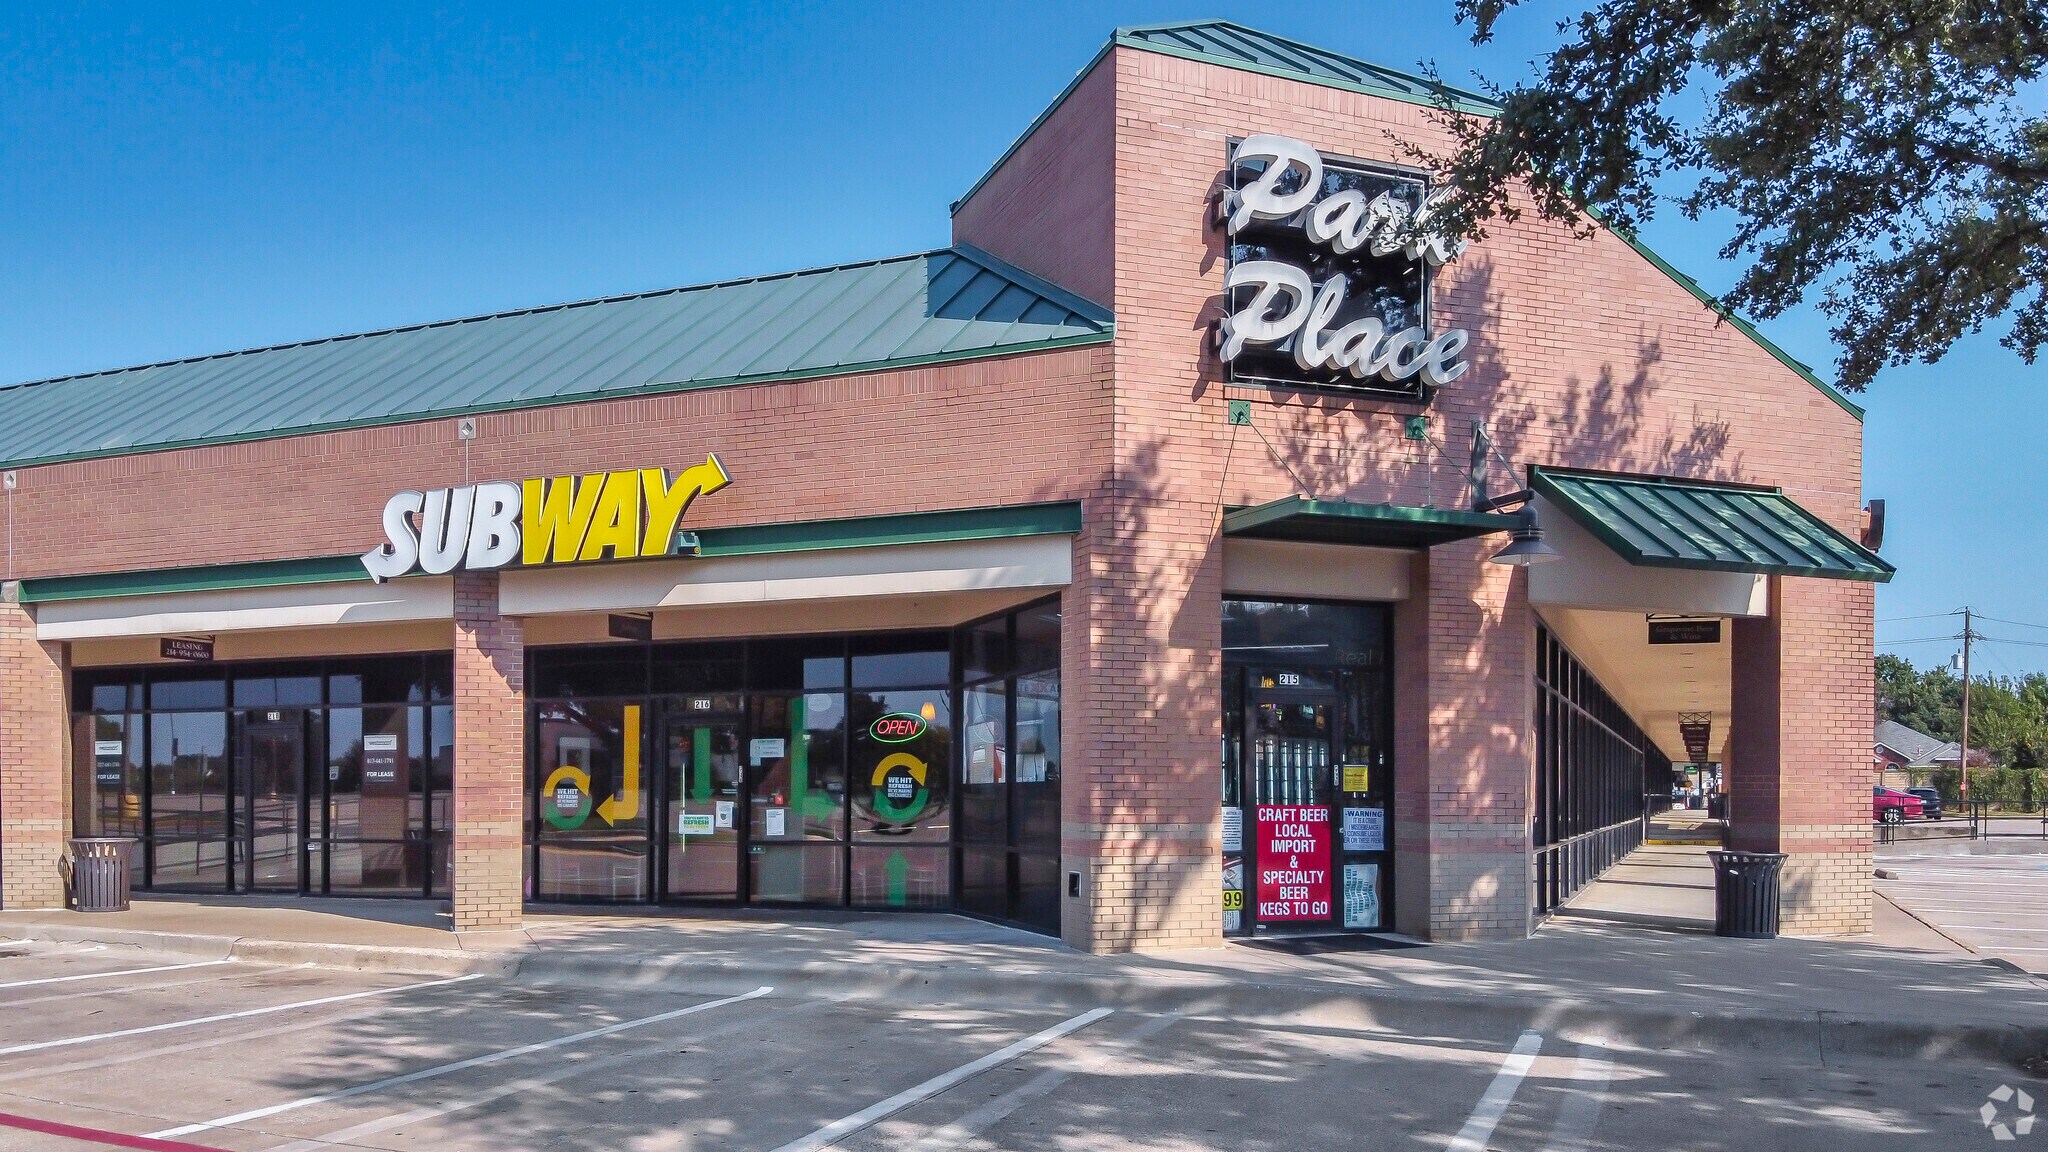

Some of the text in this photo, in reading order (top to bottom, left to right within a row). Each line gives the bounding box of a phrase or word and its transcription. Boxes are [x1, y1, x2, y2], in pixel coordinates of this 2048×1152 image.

[1220, 261, 1470, 386] Place
[360, 452, 733, 584] SUBWAY
[1655, 624, 1714, 633] Grapevine Beer
[1680, 632, 1702, 640] Wine
[172, 641, 203, 651] LEASING
[1280, 674, 1299, 685] 215
[695, 700, 710, 709] 216
[877, 719, 918, 735] OPEN
[888, 776, 913, 784] WE HIT
[1259, 808, 1328, 822] CRAFT BEER
[1275, 824, 1312, 837] LOCAL
[1271, 840, 1316, 853] IMPORT
[1289, 855, 1298, 869] &
[1263, 870, 1324, 884] SPECIALTY
[1224, 892, 1242, 907] 99
[1280, 886, 1309, 900] BEER
[1260, 901, 1328, 916] KEGS TO GO
